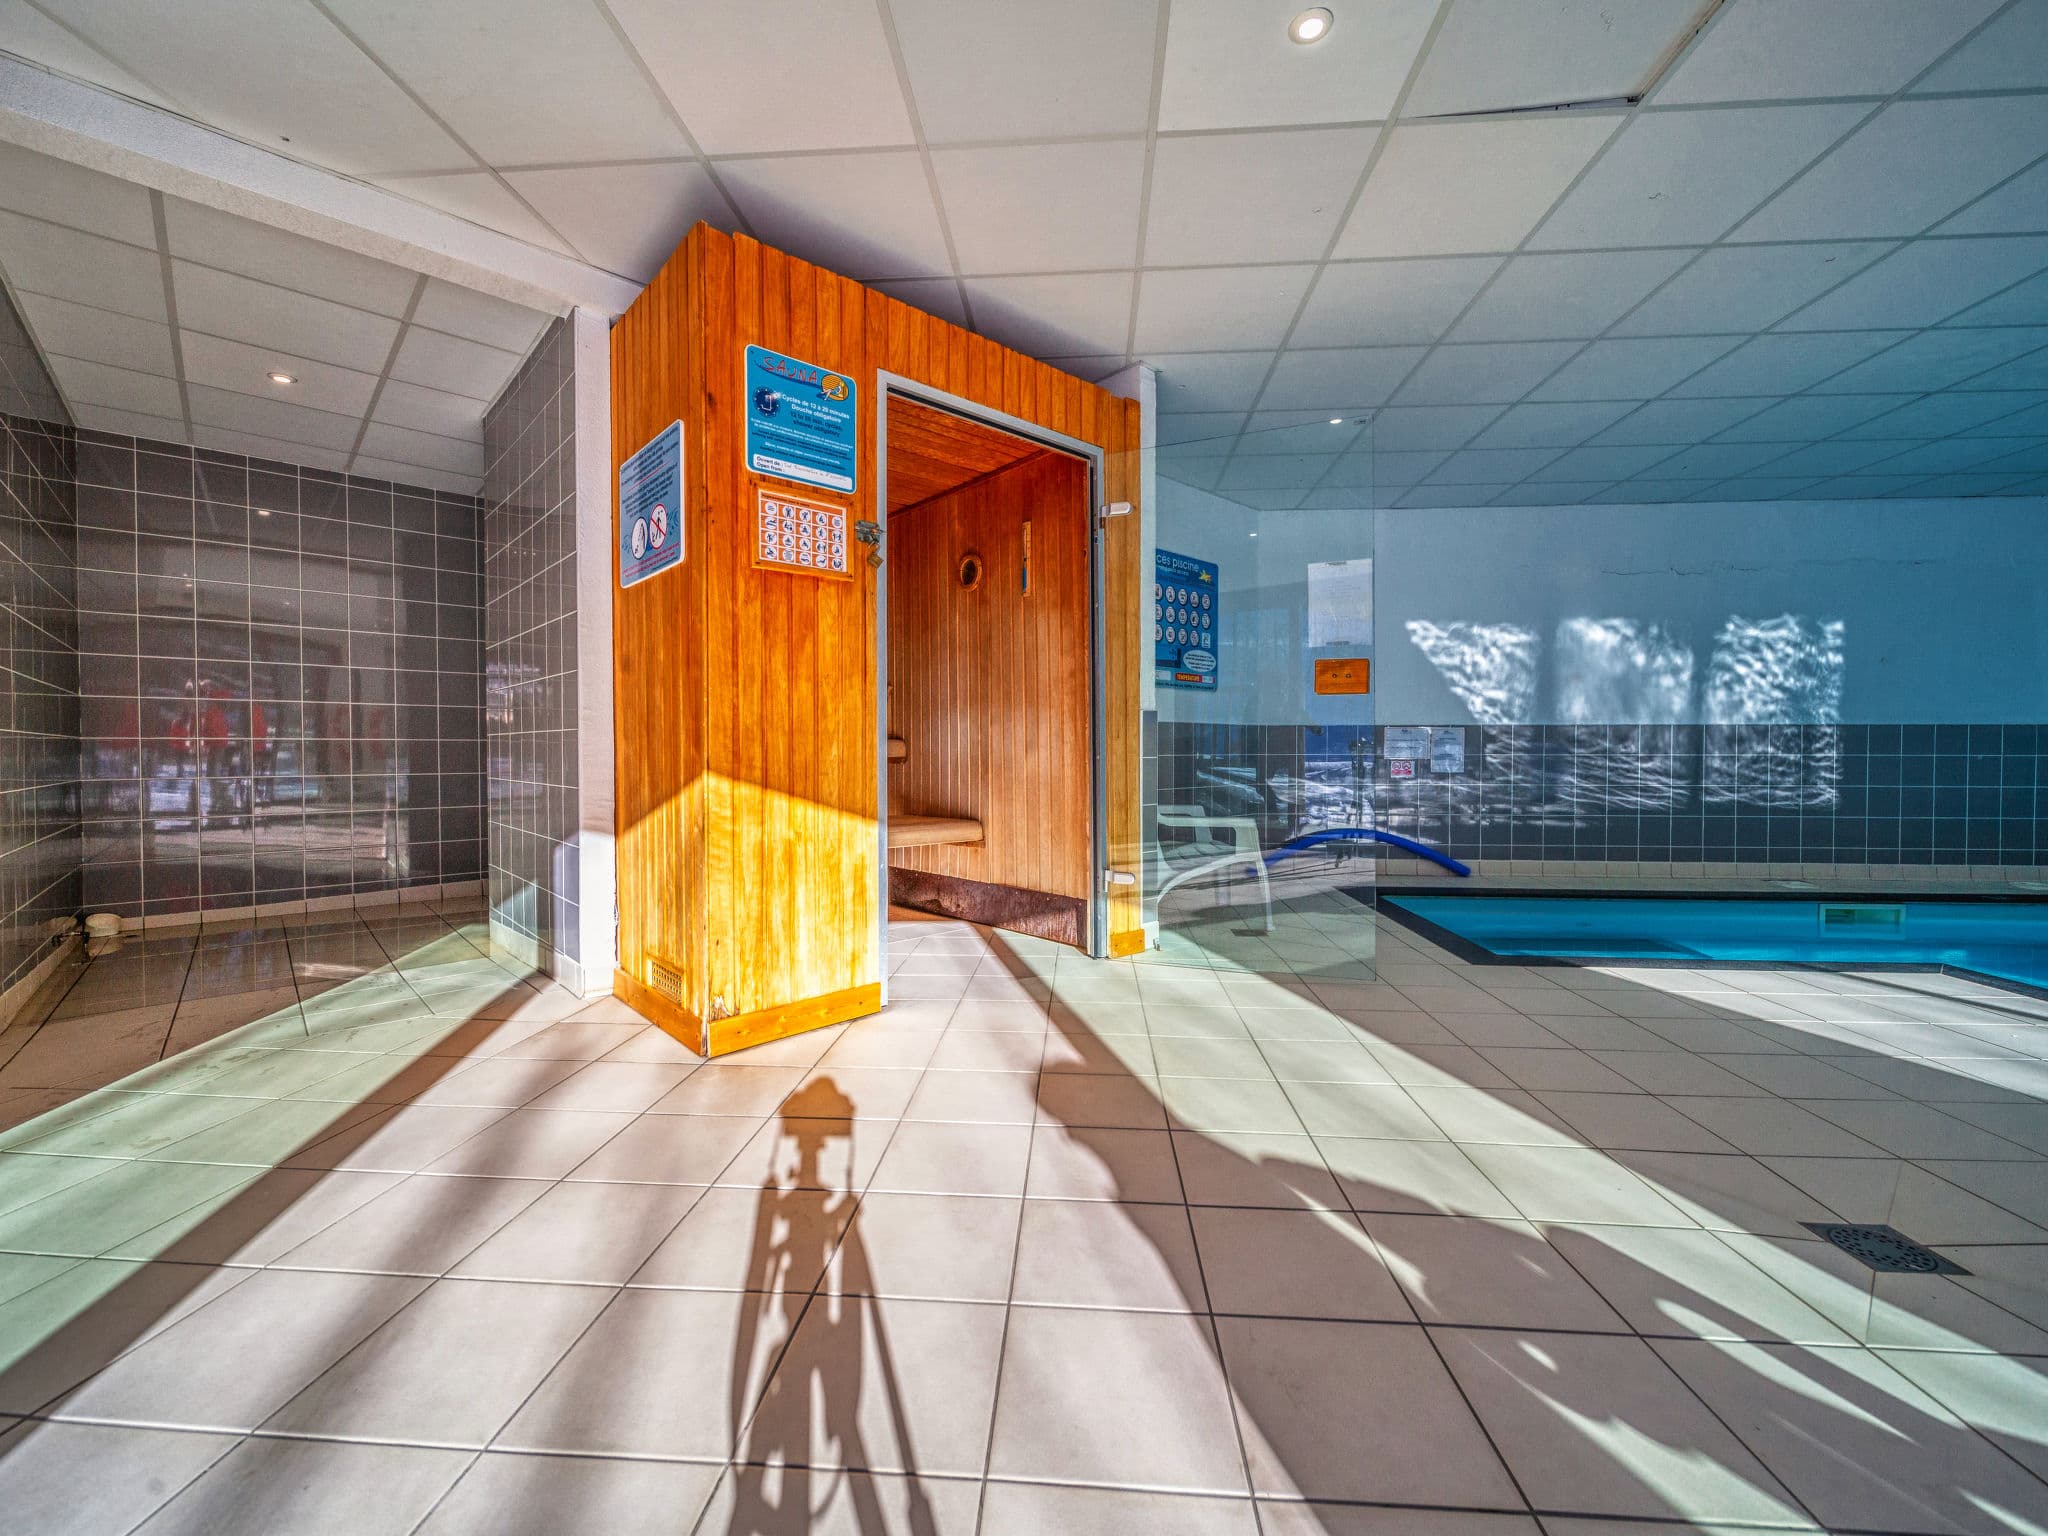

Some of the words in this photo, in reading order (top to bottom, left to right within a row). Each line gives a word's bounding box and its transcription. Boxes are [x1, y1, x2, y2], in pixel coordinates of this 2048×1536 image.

[763, 356, 817, 385] SAUNA
[782, 394, 801, 404] Cycles
[1172, 558, 1200, 573] piscine
